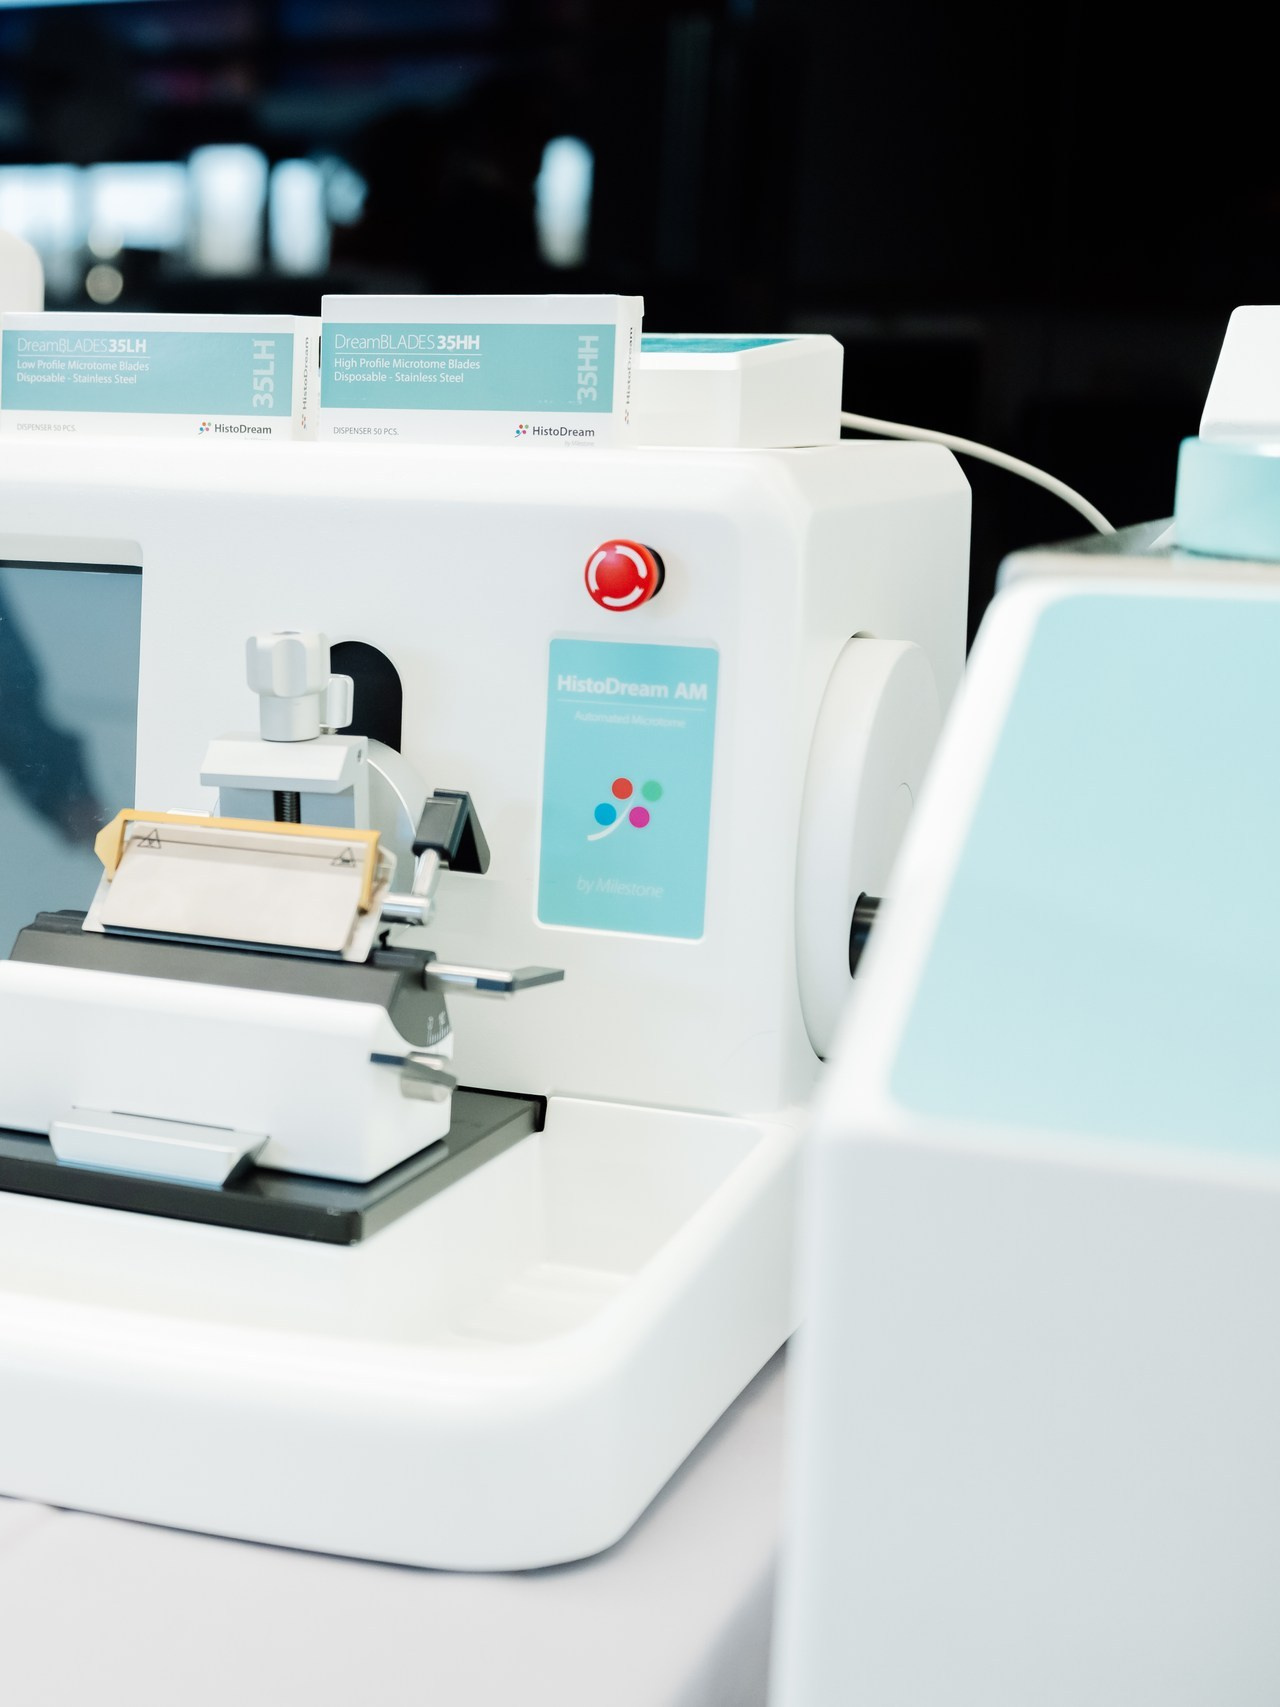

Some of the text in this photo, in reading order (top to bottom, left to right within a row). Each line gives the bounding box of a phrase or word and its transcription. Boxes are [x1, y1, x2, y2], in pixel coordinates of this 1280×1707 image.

[17, 360, 150, 371] Low Profile Microtome Blades
[334, 358, 480, 370] High Profile Microtome Blades
[577, 335, 599, 401] 35HH
[17, 373, 65, 384] Disposable
[73, 374, 112, 384] Stainless
[114, 374, 137, 384] Steel
[252, 340, 275, 408] 35LH
[334, 371, 387, 383] Disposable
[395, 372, 437, 382] Stainless
[440, 372, 464, 382] Steel
[214, 424, 272, 434] HistoDream
[532, 426, 595, 437] HistoDream
[557, 674, 708, 700] HistoDream AM
[574, 710, 686, 728] Automated Microtome
